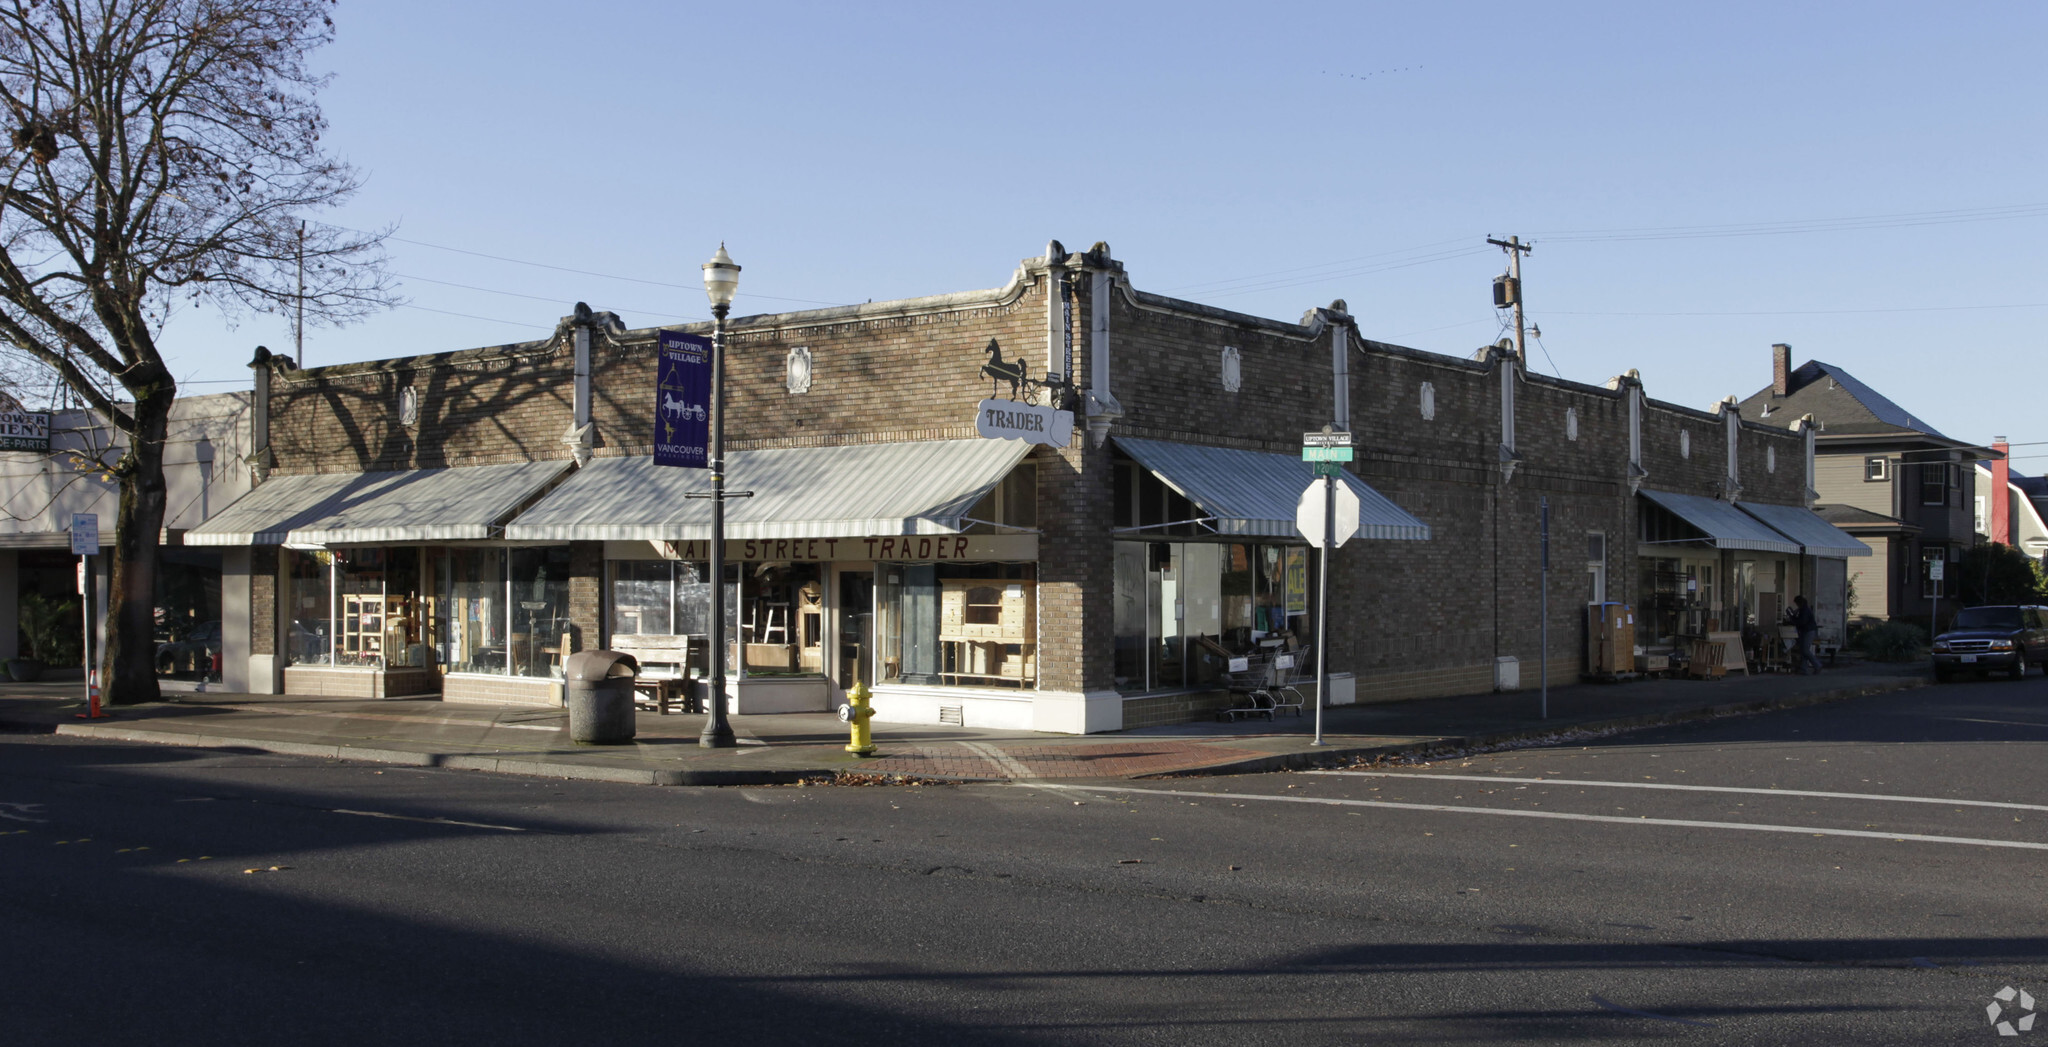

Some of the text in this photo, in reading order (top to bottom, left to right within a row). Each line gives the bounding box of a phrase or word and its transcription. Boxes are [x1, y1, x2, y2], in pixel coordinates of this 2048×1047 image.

[668, 339, 703, 352] UPTOWN
[669, 351, 702, 364] VILLAGE
[986, 408, 1044, 432] TRADER
[657, 443, 704, 456] VANCOUVER
[1308, 449, 1339, 460] MAIN
[744, 538, 839, 559] STREET
[863, 536, 969, 559] TRADER
[1287, 567, 1305, 594] ALE
